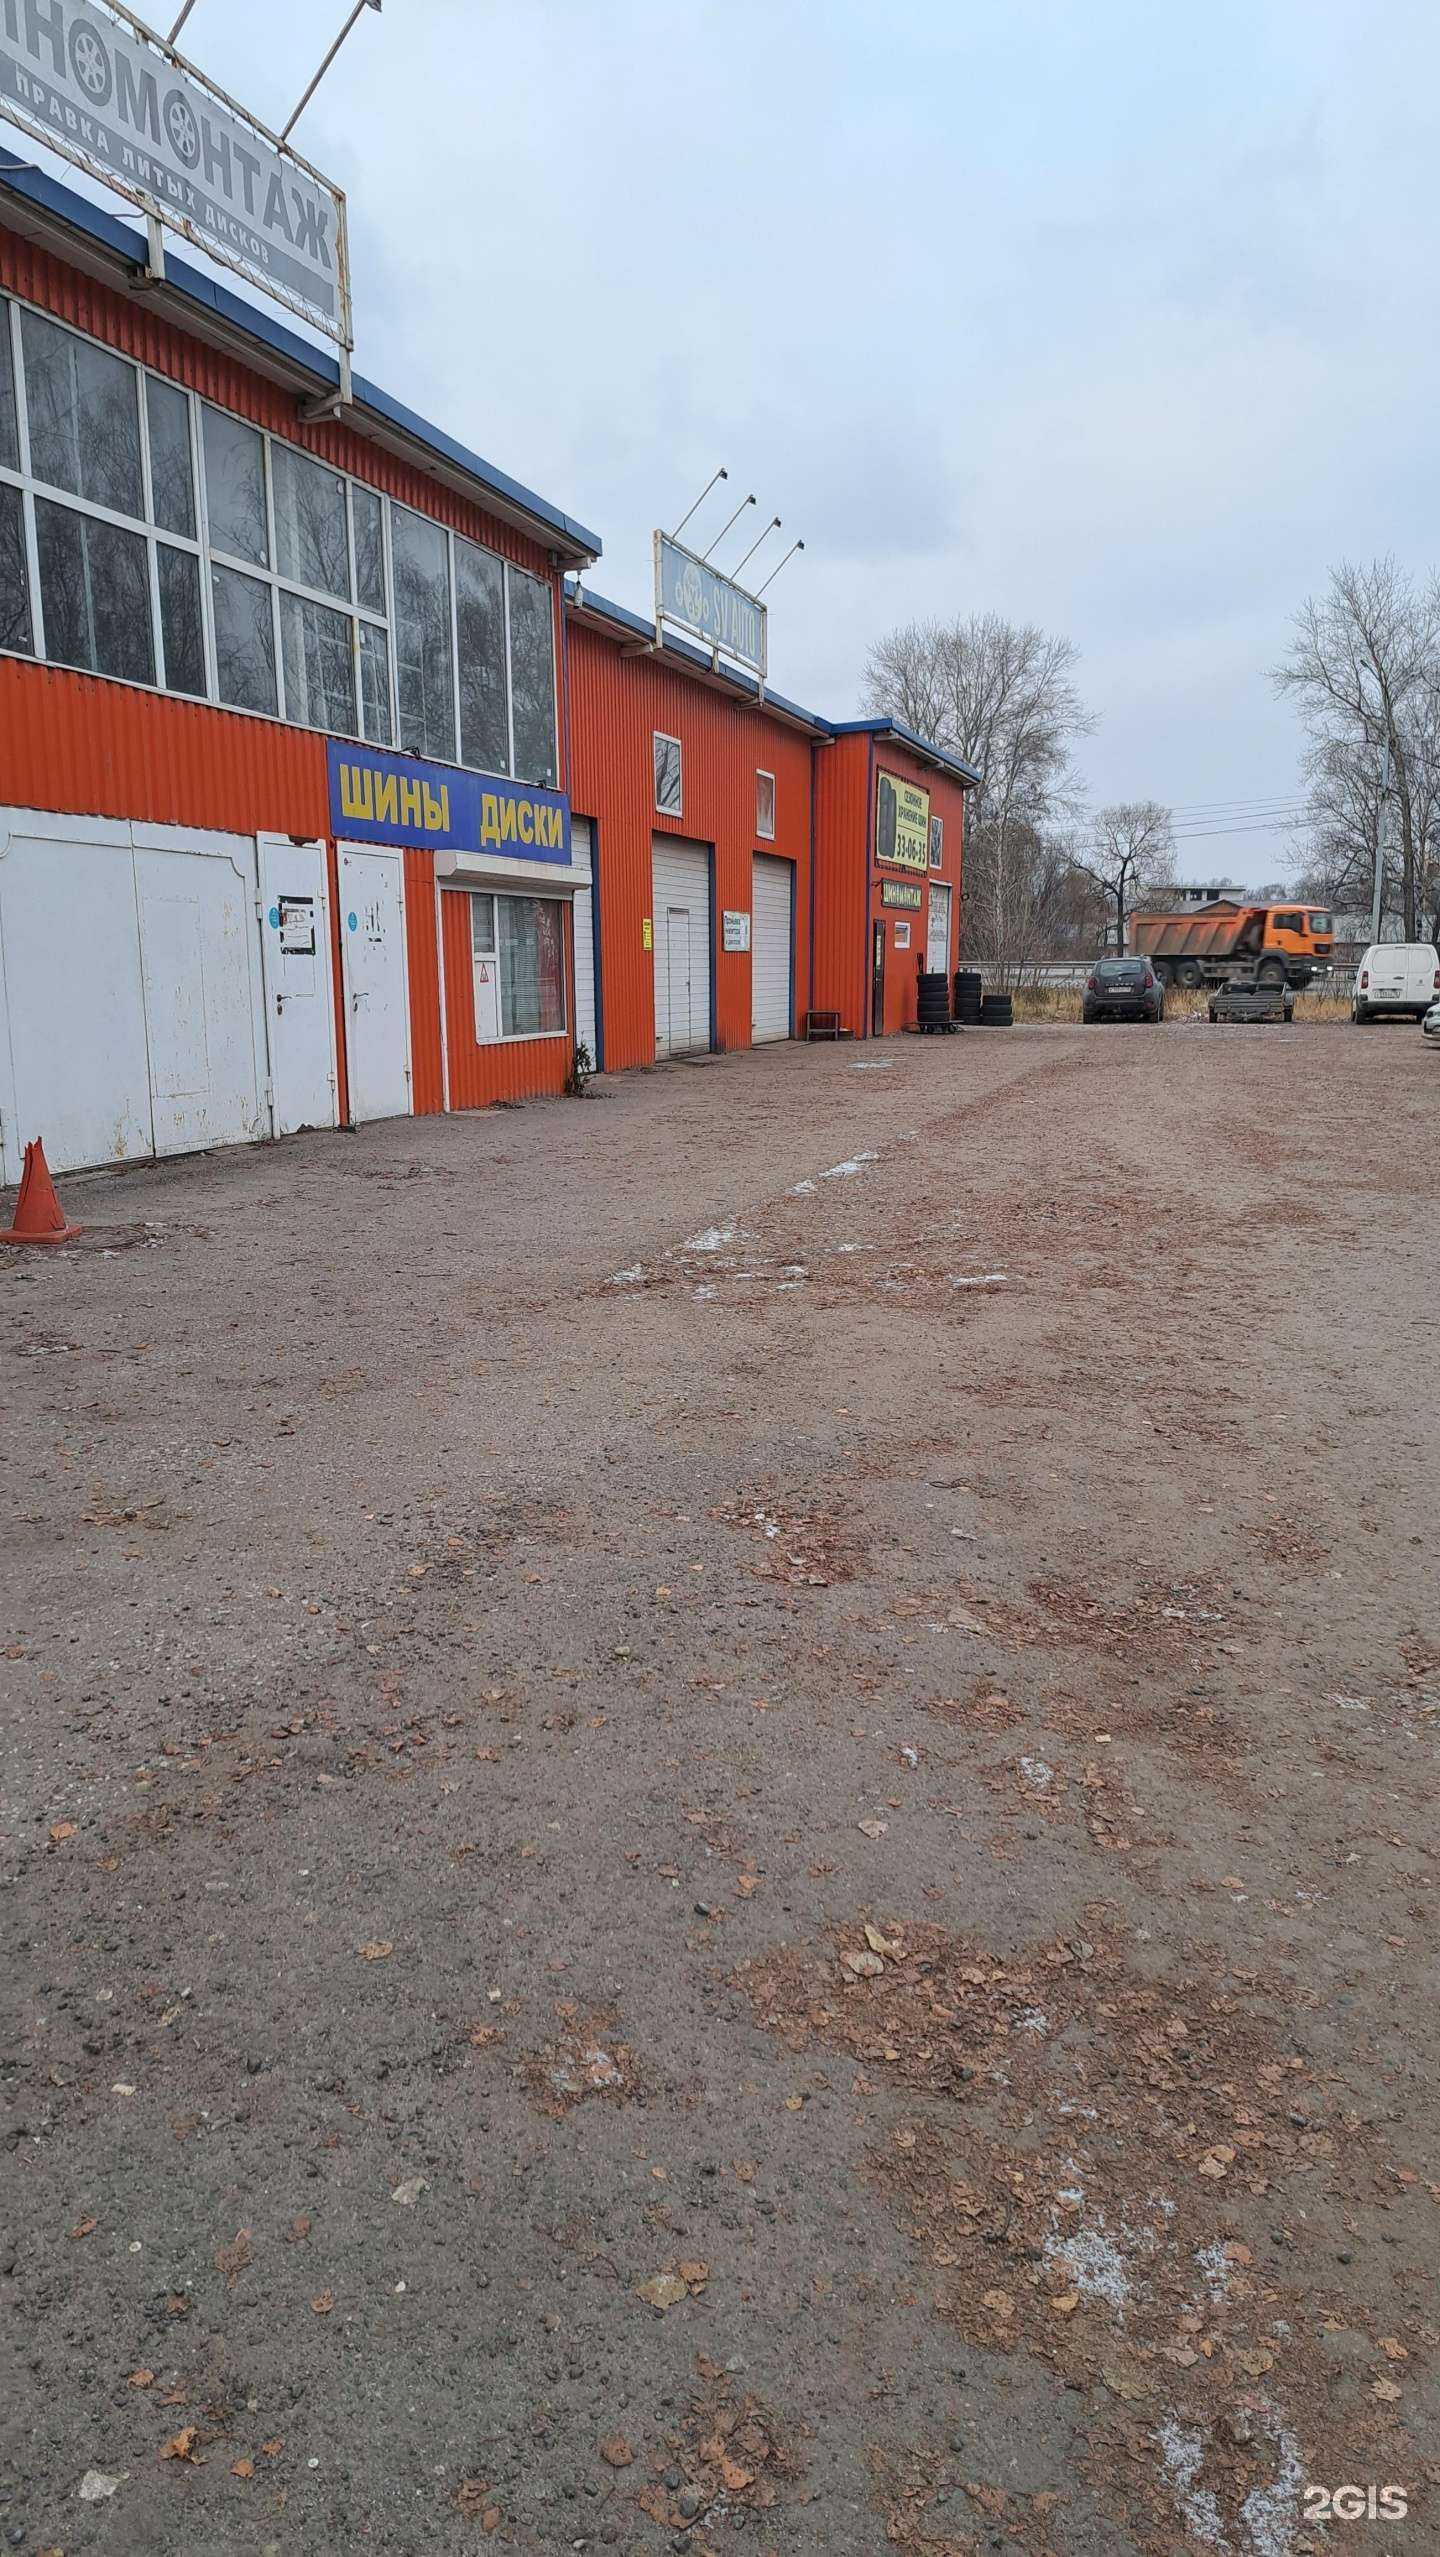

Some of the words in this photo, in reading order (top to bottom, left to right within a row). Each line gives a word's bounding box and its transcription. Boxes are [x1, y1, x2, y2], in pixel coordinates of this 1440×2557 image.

[15, 62, 111, 154] ПРАВКА
[122, 146, 196, 211] ЛИТЫХ
[205, 203, 269, 264] ДИСКОВ
[731, 597, 755, 657] AUTO
[339, 763, 450, 832] ШИНЫ
[480, 793, 564, 849] ДИСКИ
